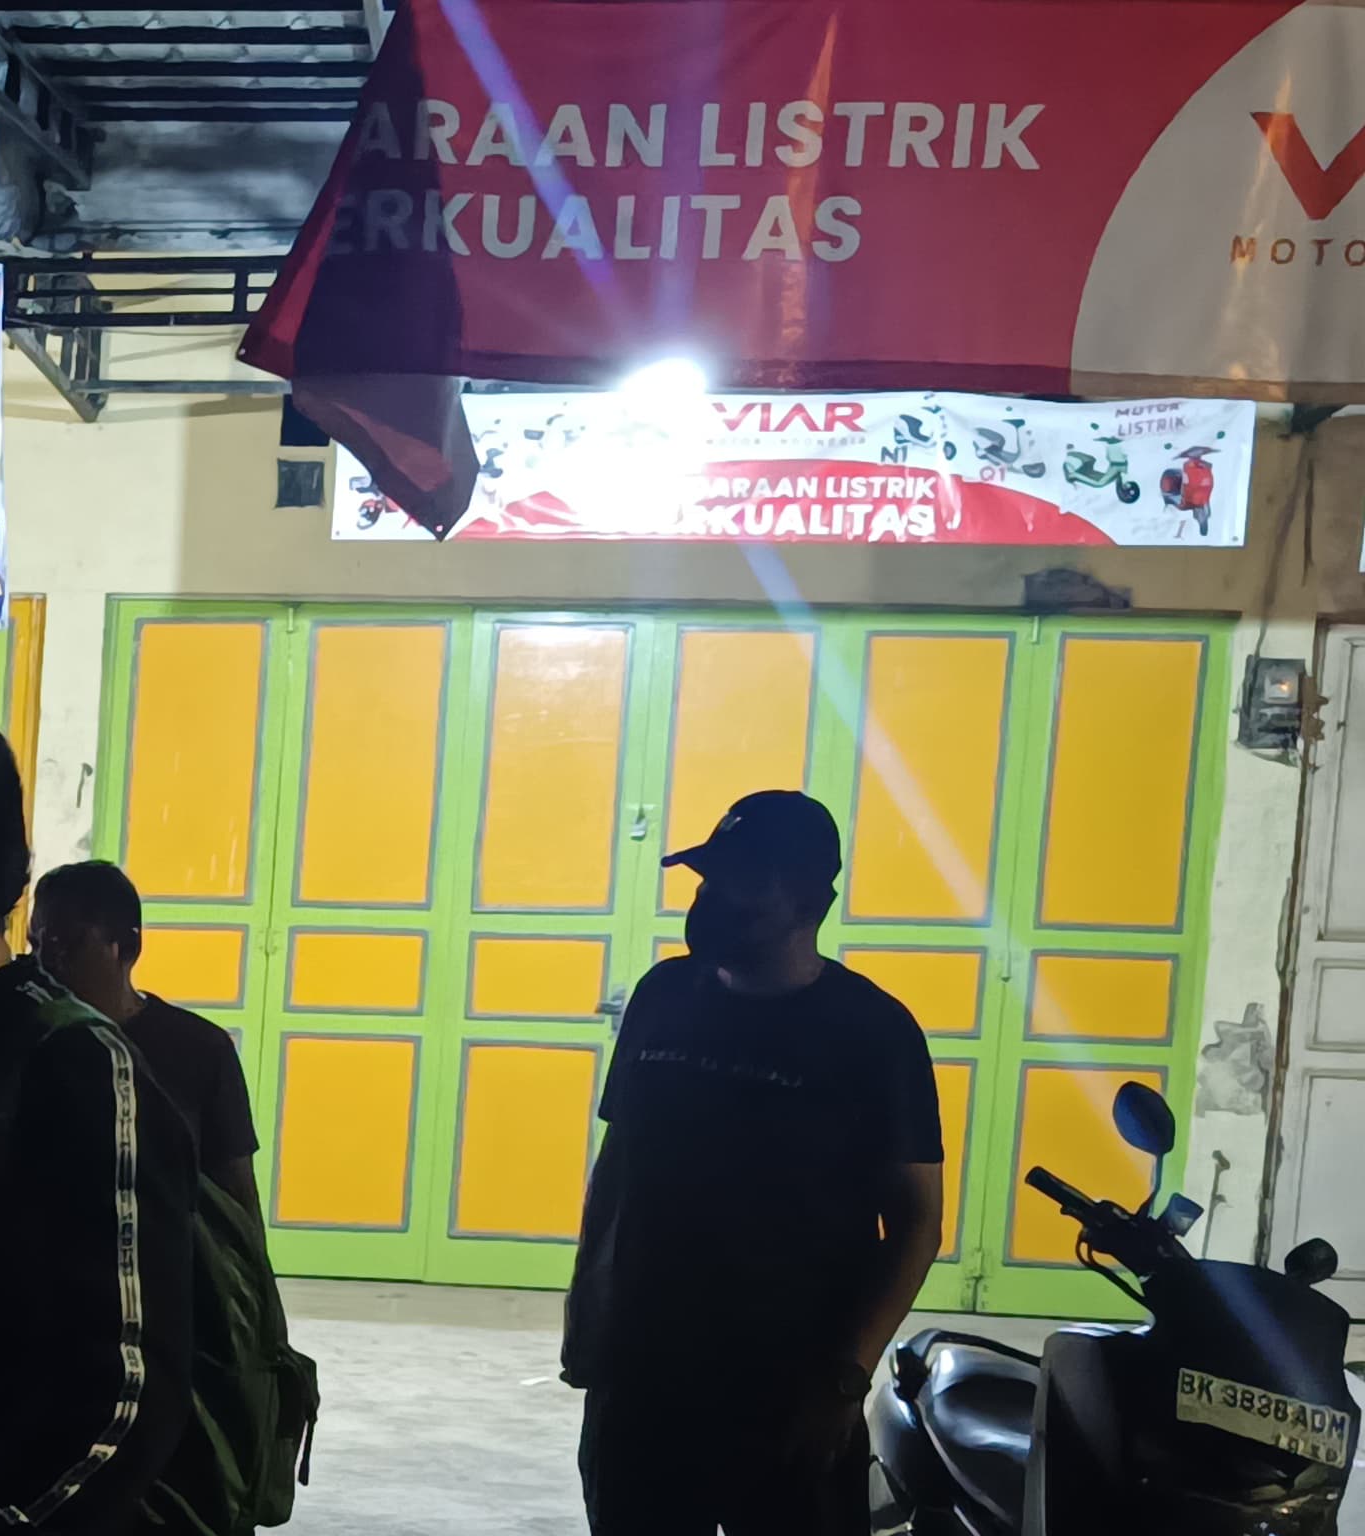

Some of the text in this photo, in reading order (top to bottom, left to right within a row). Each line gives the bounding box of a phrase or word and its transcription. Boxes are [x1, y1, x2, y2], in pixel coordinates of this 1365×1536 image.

[699, 102, 1047, 170] LISTRIK
[710, 401, 869, 433] VIAR
[1118, 416, 1186, 437] LISTRIK
[700, 477, 936, 499] ARAAN LISTRIK
[1180, 1371, 1214, 1405] BK
